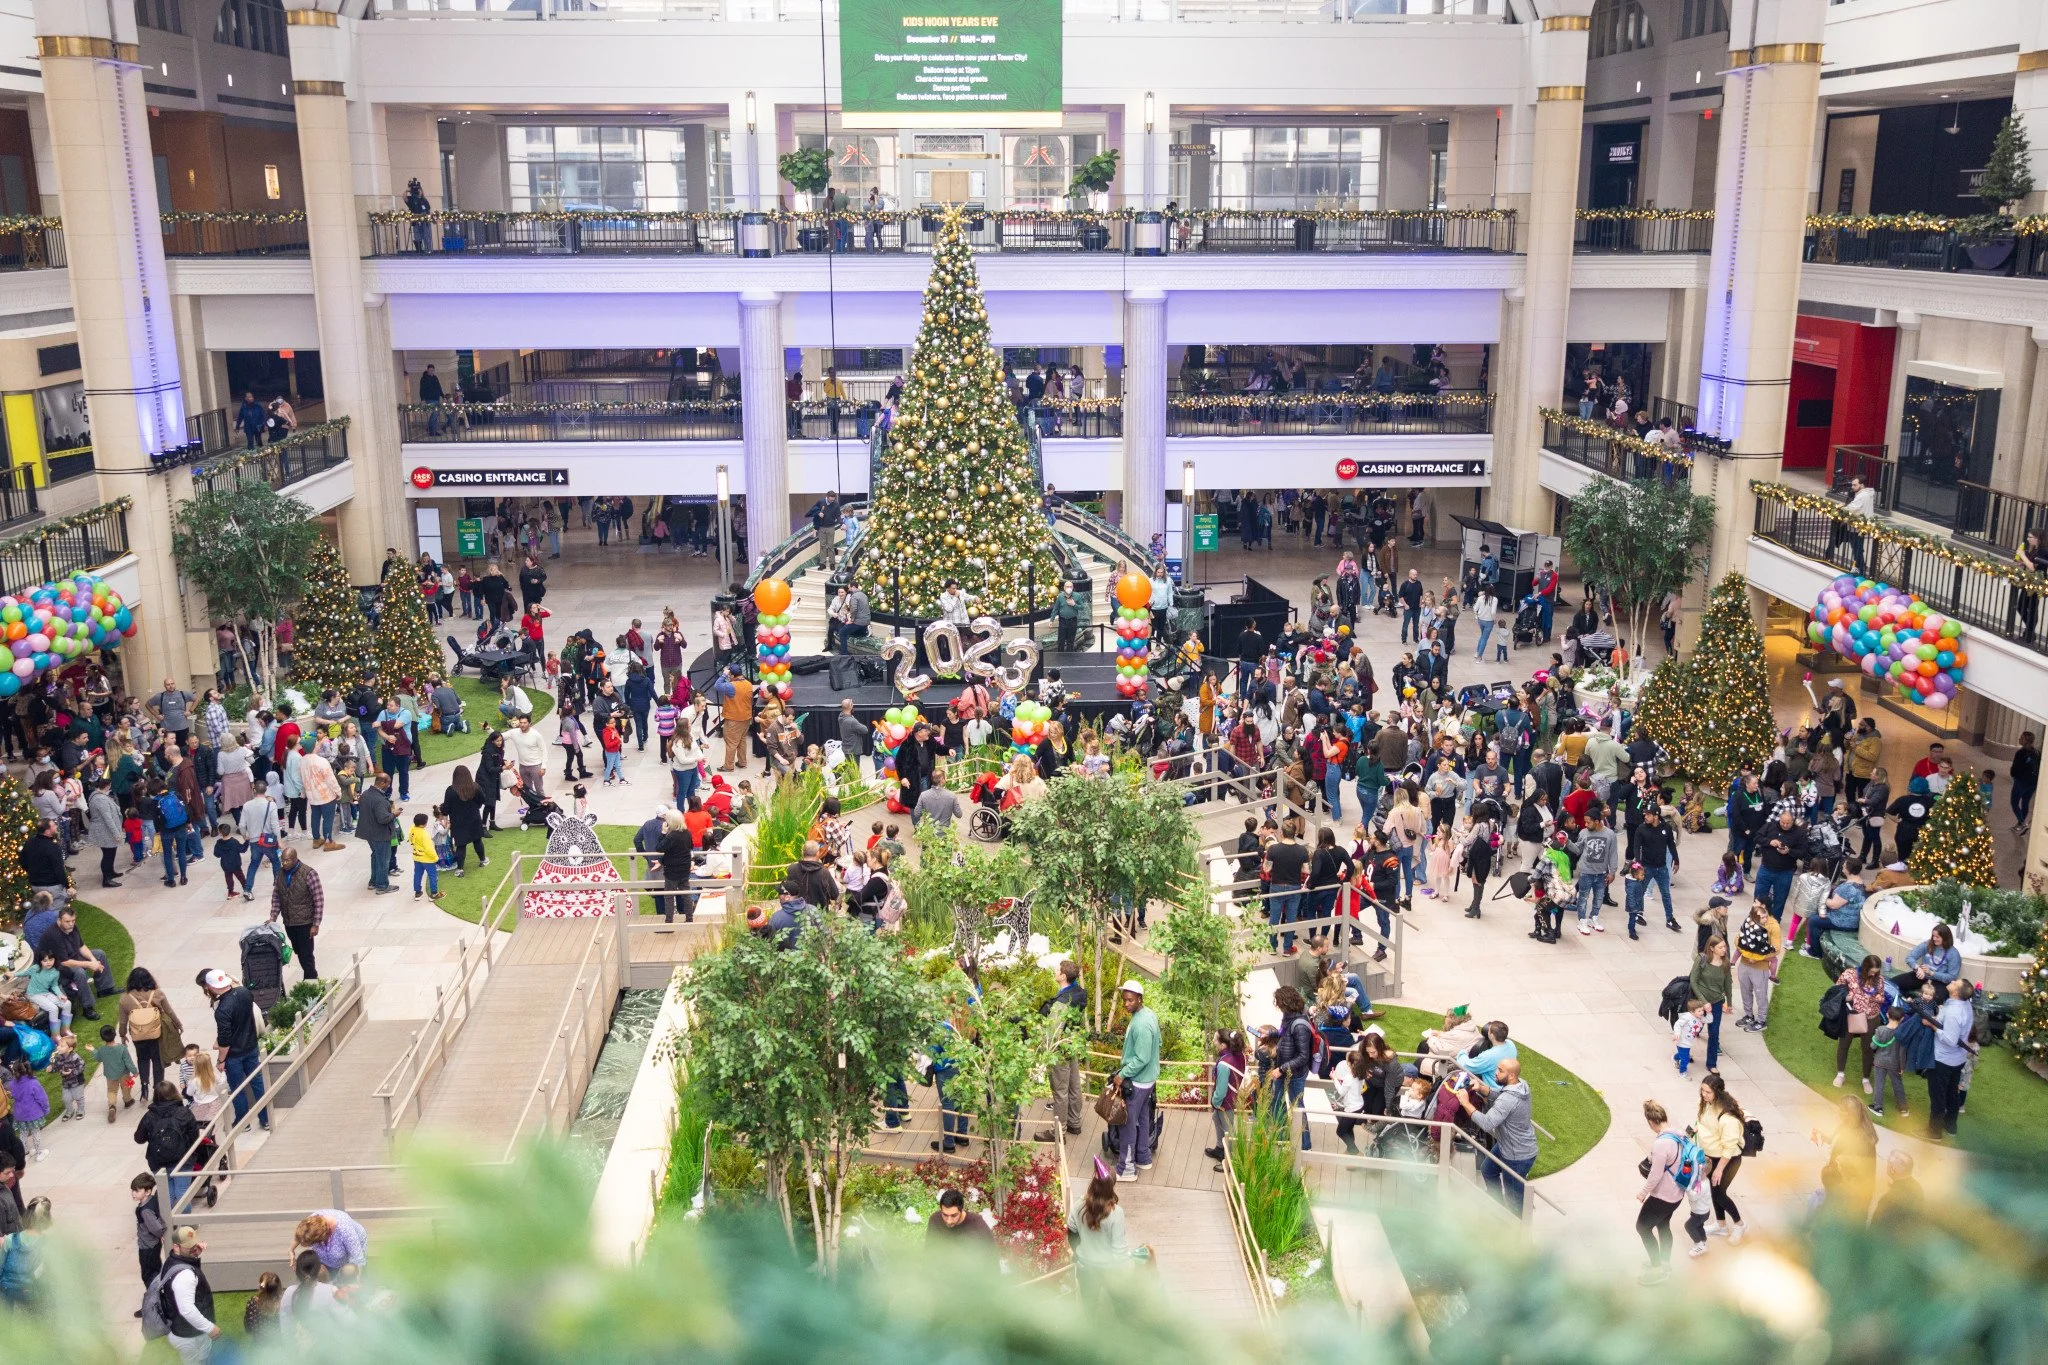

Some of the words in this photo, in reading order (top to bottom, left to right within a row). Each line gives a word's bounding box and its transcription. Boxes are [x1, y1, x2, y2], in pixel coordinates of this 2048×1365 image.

[903, 17, 923, 27] KIDS
[924, 17, 950, 27] NOON
[950, 17, 979, 27] YEARS
[980, 17, 998, 27] EVE
[906, 35, 940, 44] December
[875, 54, 890, 62] Bring
[904, 54, 921, 62] family
[1014, 54, 1028, 62] City!
[923, 66, 944, 74] Balloon
[944, 66, 957, 75] drop
[969, 75, 988, 84] greets
[951, 84, 971, 92] parties
[955, 93, 979, 101] painters
[1362, 464, 1404, 474] CASINO
[1406, 463, 1464, 473] ENTRANCE
[439, 473, 483, 483] CASINO
[485, 473, 547, 482] ENTRANCE
[881, 617, 1040, 695] 2023
